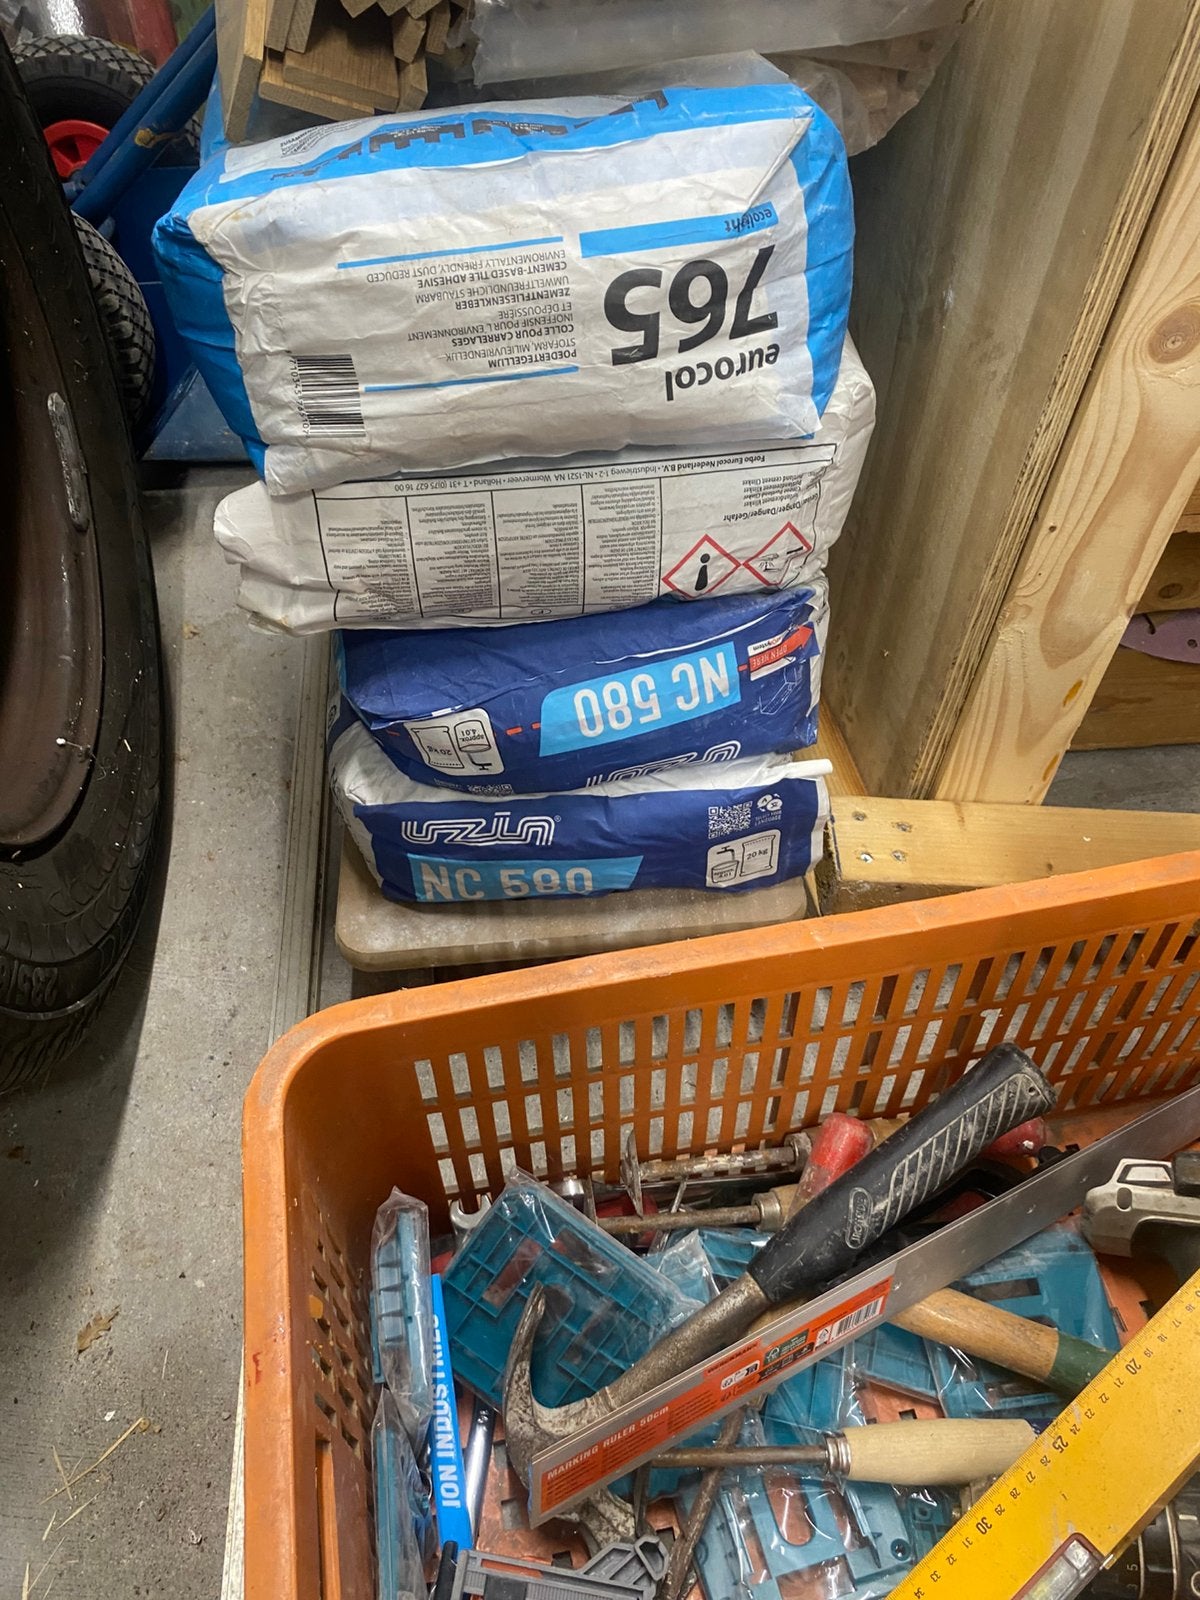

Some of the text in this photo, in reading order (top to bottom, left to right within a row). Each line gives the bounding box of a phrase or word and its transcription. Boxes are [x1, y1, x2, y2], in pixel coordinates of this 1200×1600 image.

[725, 208, 773, 236] ecolight
[410, 265, 436, 277] DUST
[437, 259, 483, 273] FRIENDLY,
[366, 268, 410, 282] REDUCED
[416, 260, 567, 287] CEMENT-BASED TILE ADHESIVE
[414, 275, 569, 303] UMWELTFREUNDLICHE STAUBARM
[454, 286, 570, 310] ZEMENTFLIESENKLEBER
[497, 301, 572, 320] ET DÉPOUSSIÈRE
[603, 244, 778, 366] 765
[492, 319, 519, 331] POUR
[520, 312, 573, 327] INOFFENSIF
[451, 323, 574, 346] COLLE POUR CARRELAGES
[444, 336, 576, 362] STOFARM, MILIEUVRIENDELIJK
[487, 348, 577, 368] POEDERTEGELLIJM
[664, 343, 780, 401] eurocol
[677, 460, 715, 470] Nederland
[715, 457, 743, 467] Eurocol
[743, 455, 765, 464] Forbo
[610, 465, 657, 476] Industrieweg
[660, 463, 676, 472] B.V.
[506, 473, 551, 484] Wormerveer
[553, 472, 565, 480] NA
[565, 470, 593, 479] NL-1521
[415, 482, 428, 490] 627
[448, 479, 461, 488] +31
[462, 479, 468, 487] T
[472, 476, 501, 486] Holland
[393, 483, 404, 492] 00
[404, 483, 413, 491] 16
[768, 643, 788, 660] OPEN
[677, 650, 732, 711] NC
[573, 674, 662, 738] 580
[458, 733, 484, 743] approx.
[426, 745, 439, 754] kg
[746, 851, 757, 860] 20
[420, 862, 484, 899] NC
[1171, 1318, 1182, 1328] 17
[1158, 1334, 1167, 1342] 18
[1144, 1348, 1153, 1358] 19
[1125, 1359, 1141, 1375] 20
[432, 1313, 454, 1459] INDUSTRIE
[1114, 1378, 1123, 1387] 21
[1100, 1394, 1109, 1403] 22
[1085, 1409, 1094, 1419] 23
[1070, 1425, 1080, 1435] 24
[545, 1444, 600, 1480] MARKING
[600, 1423, 637, 1448] RULER
[637, 1405, 670, 1427] 50cm
[1051, 1436, 1069, 1453] 25
[1040, 1456, 1050, 1466] 26
[1025, 1472, 1035, 1482] 27
[1010, 1488, 1020, 1498] 28
[995, 1505, 1005, 1515] 29
[975, 1517, 992, 1534] 30
[962, 1538, 973, 1548] 31
[946, 1554, 957, 1565] 32
[930, 1571, 941, 1582] 33
[912, 1586, 926, 1600] 34
